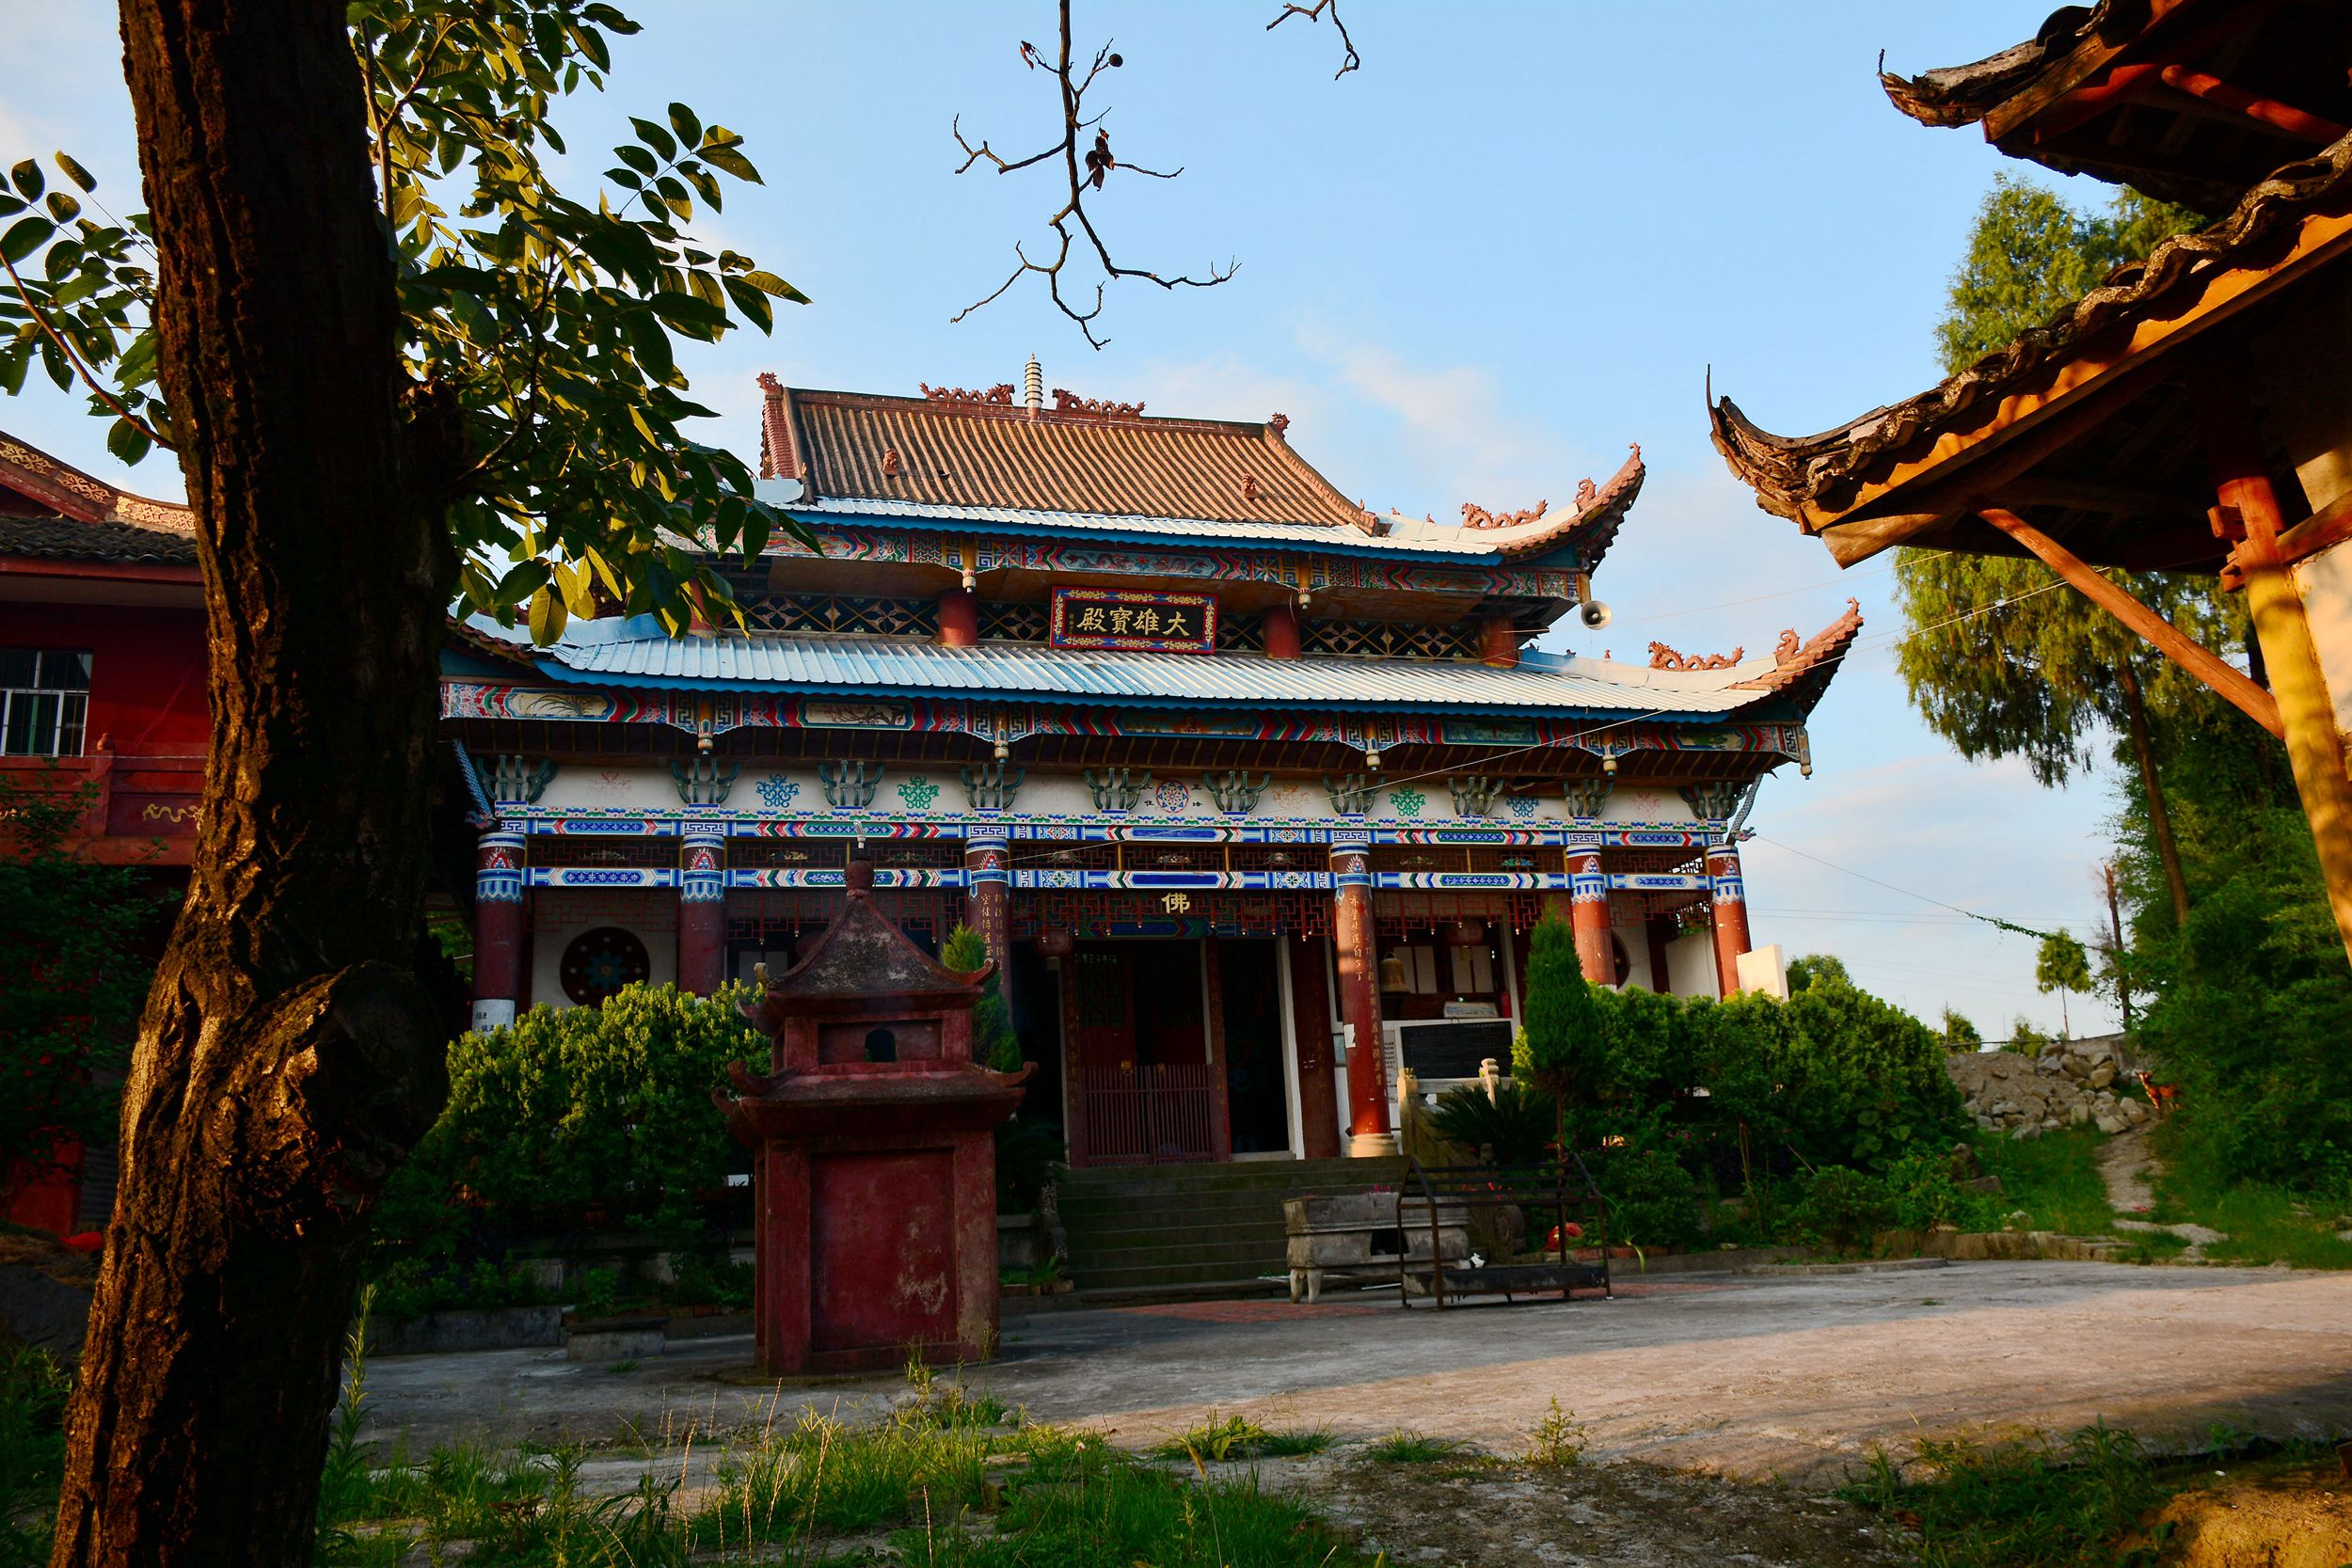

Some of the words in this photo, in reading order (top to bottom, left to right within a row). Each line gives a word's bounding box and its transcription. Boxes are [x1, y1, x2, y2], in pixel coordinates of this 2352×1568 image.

[1076, 606, 1190, 637] 大雄寶殿
[1161, 892, 1190, 914] 佛
